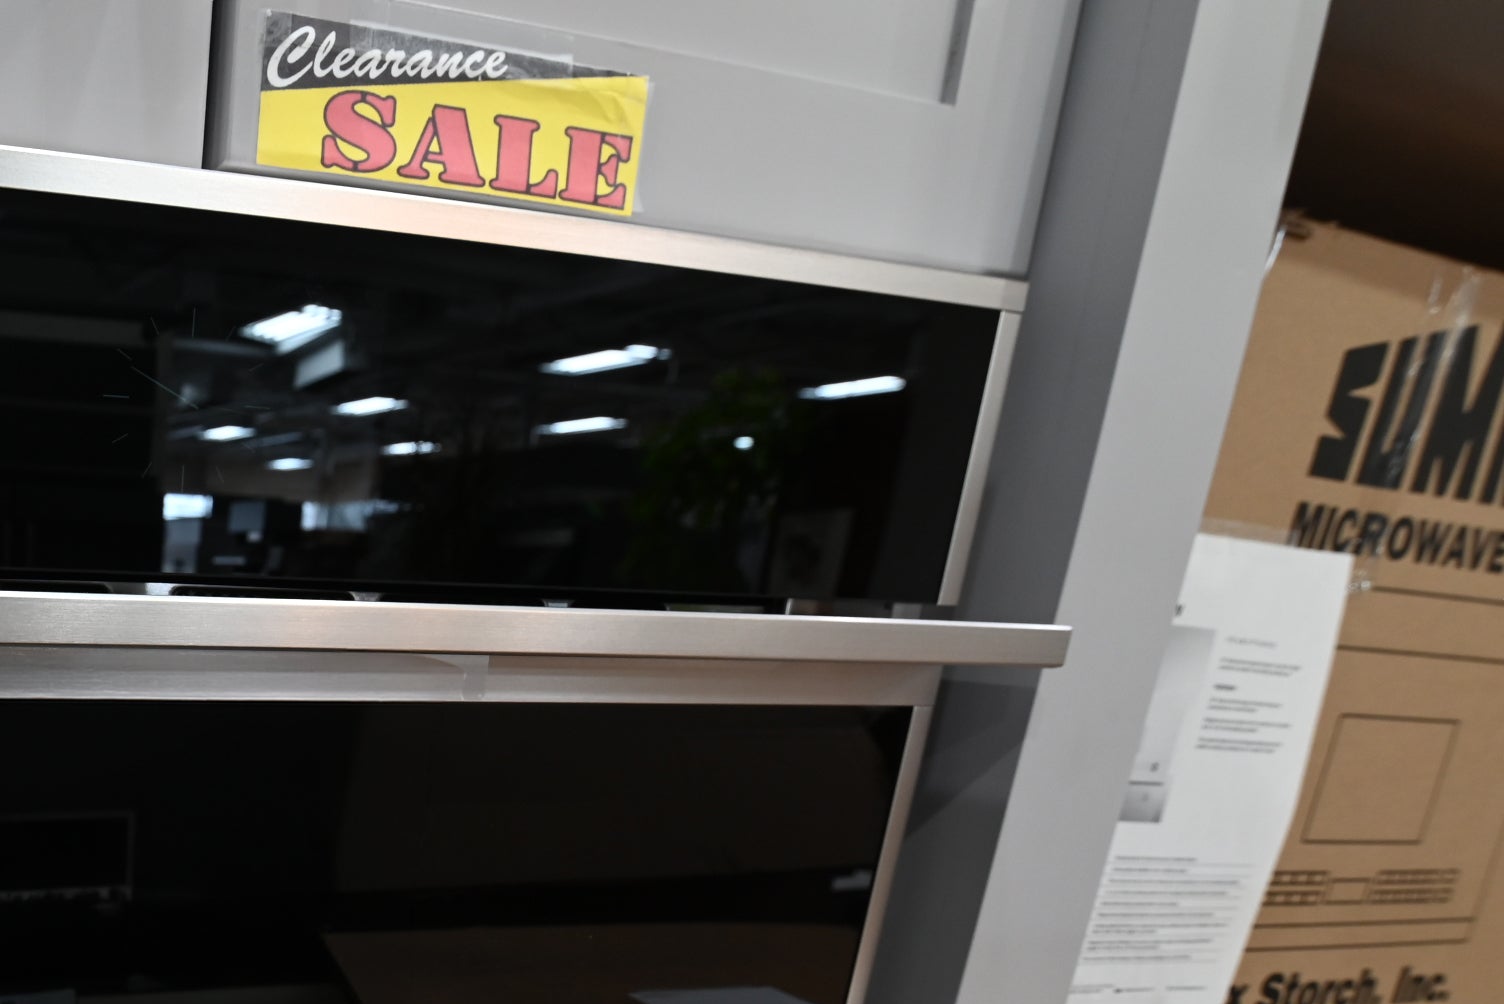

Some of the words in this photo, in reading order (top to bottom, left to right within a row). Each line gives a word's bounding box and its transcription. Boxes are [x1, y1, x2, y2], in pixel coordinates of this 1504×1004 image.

[266, 25, 508, 88] Clearance
[320, 90, 634, 211] SALE
[1307, 318, 1504, 508] SUM
[1391, 964, 1450, 1004] Inc.
